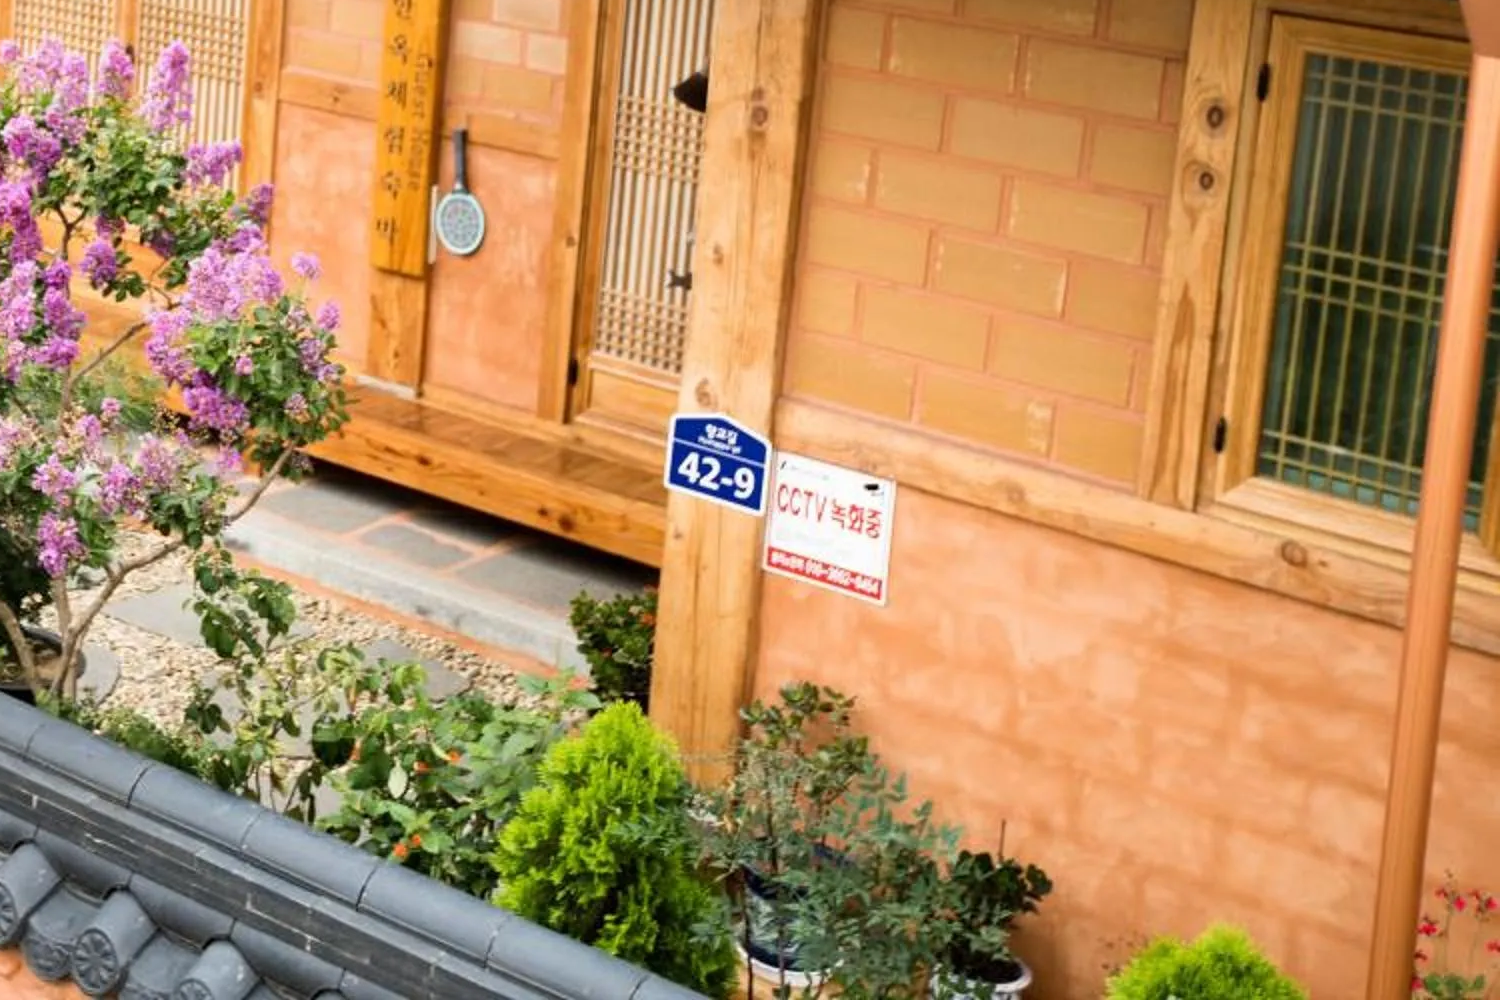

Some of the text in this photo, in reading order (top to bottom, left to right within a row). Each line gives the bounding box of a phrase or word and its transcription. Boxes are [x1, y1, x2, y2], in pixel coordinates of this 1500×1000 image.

[677, 451, 756, 499] 42-9
[777, 483, 883, 539] CCTV 녹화중
